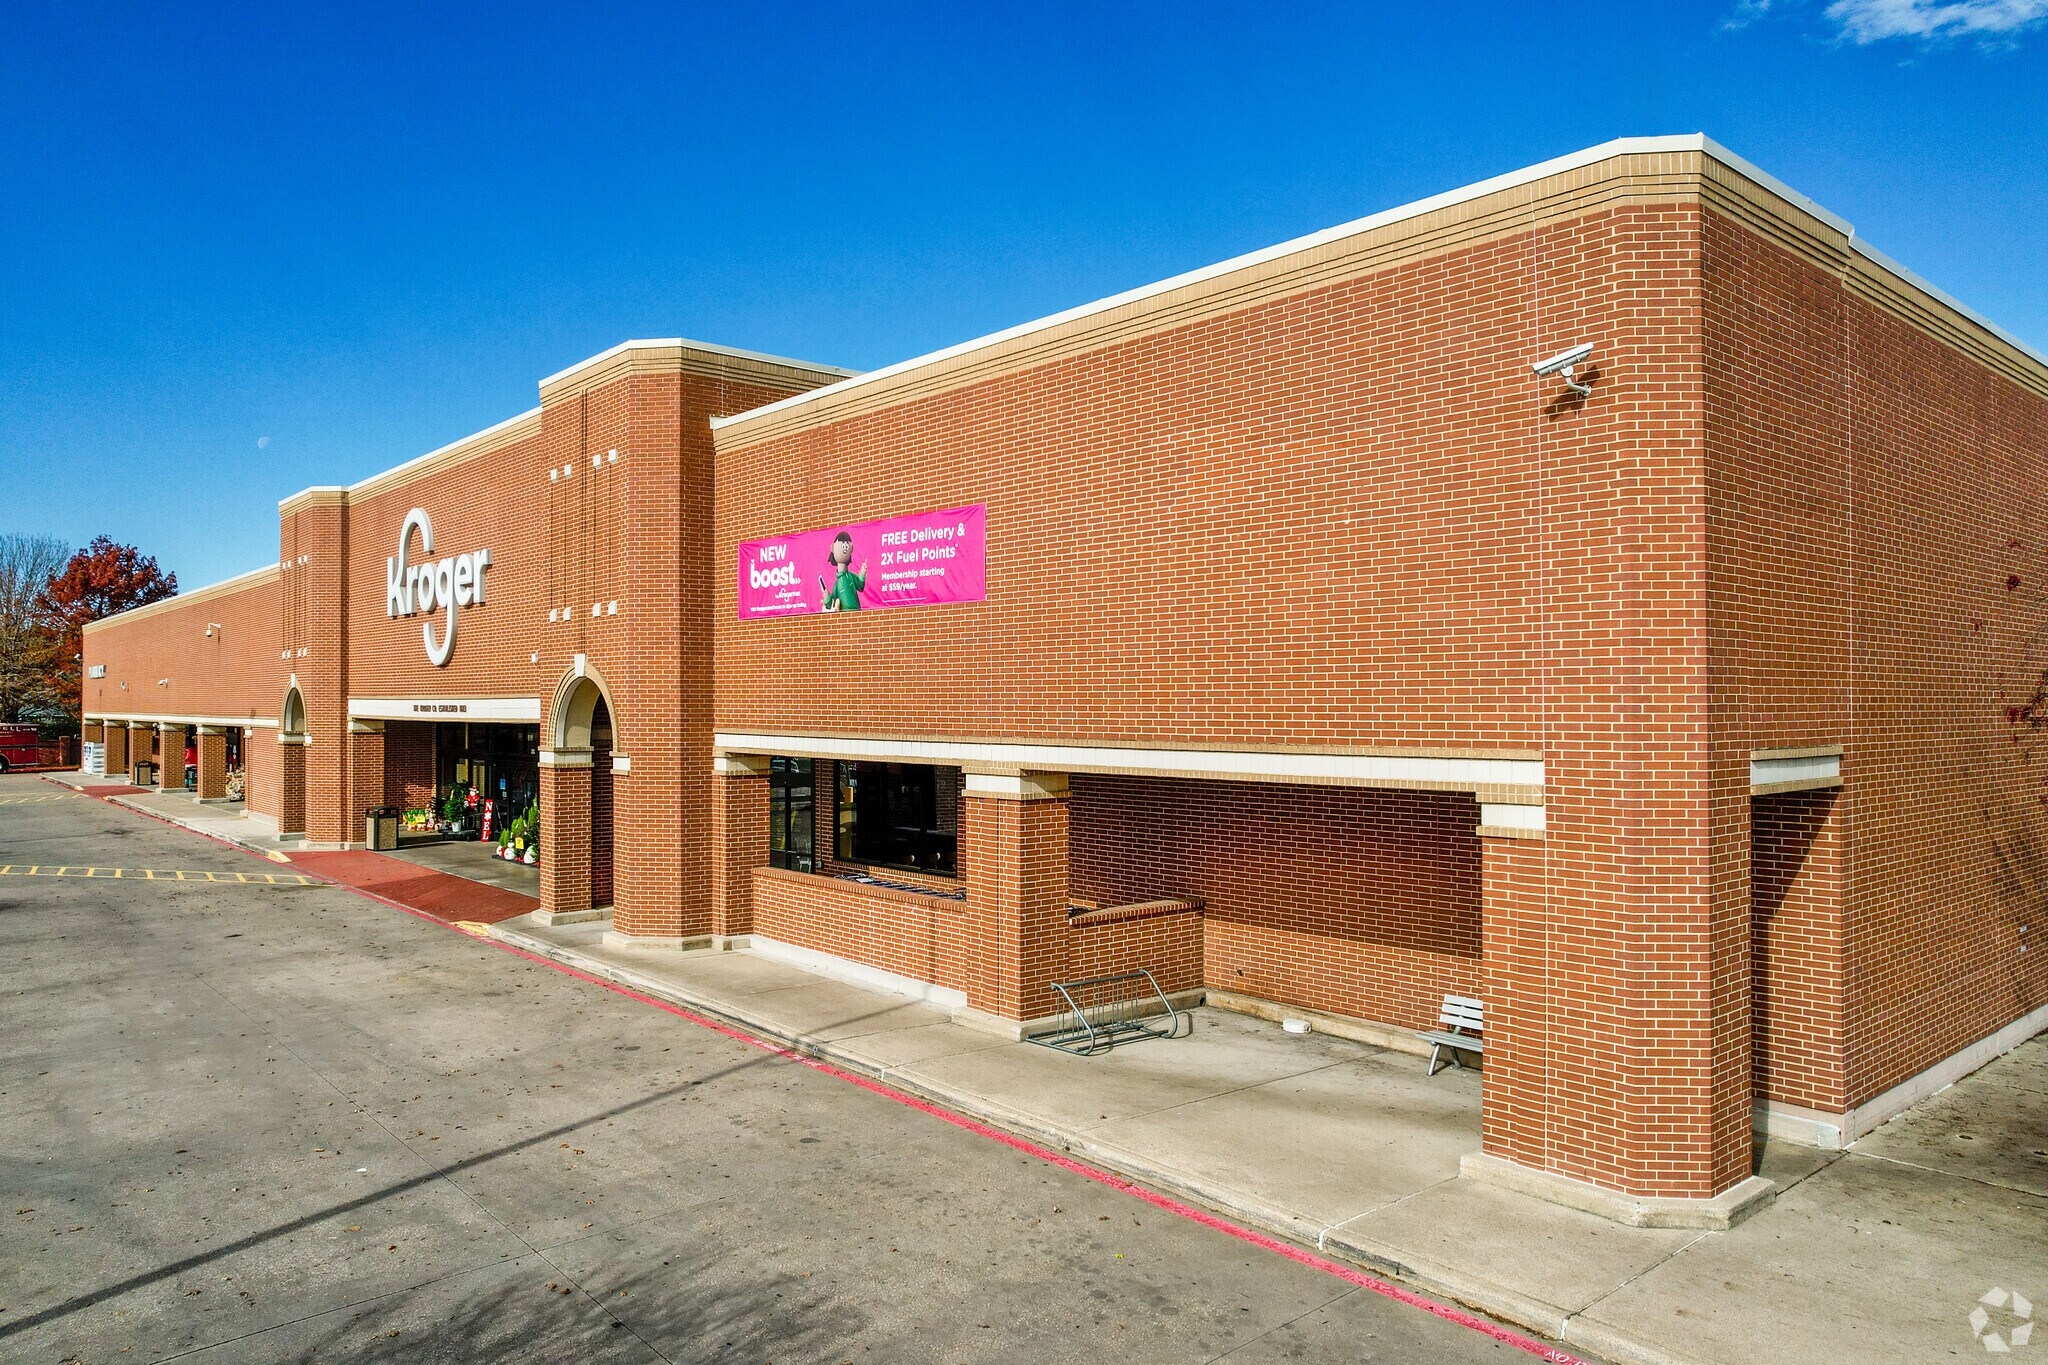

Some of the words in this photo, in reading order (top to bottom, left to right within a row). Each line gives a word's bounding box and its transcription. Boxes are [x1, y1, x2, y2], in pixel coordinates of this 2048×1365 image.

[881, 530, 908, 547] FREE
[910, 526, 955, 543] Delivery
[957, 522, 966, 537] &
[760, 543, 787, 563] NEW
[880, 551, 894, 566] 2X
[896, 548, 919, 564] Fuel
[750, 560, 797, 590] boost
[881, 569, 918, 581] Membership
[919, 566, 945, 577] starting
[387, 507, 494, 667] Kroger
[881, 584, 888, 592] at
[889, 581, 918, 592] $59/year.
[1545, 1350, 1570, 1363] NO
